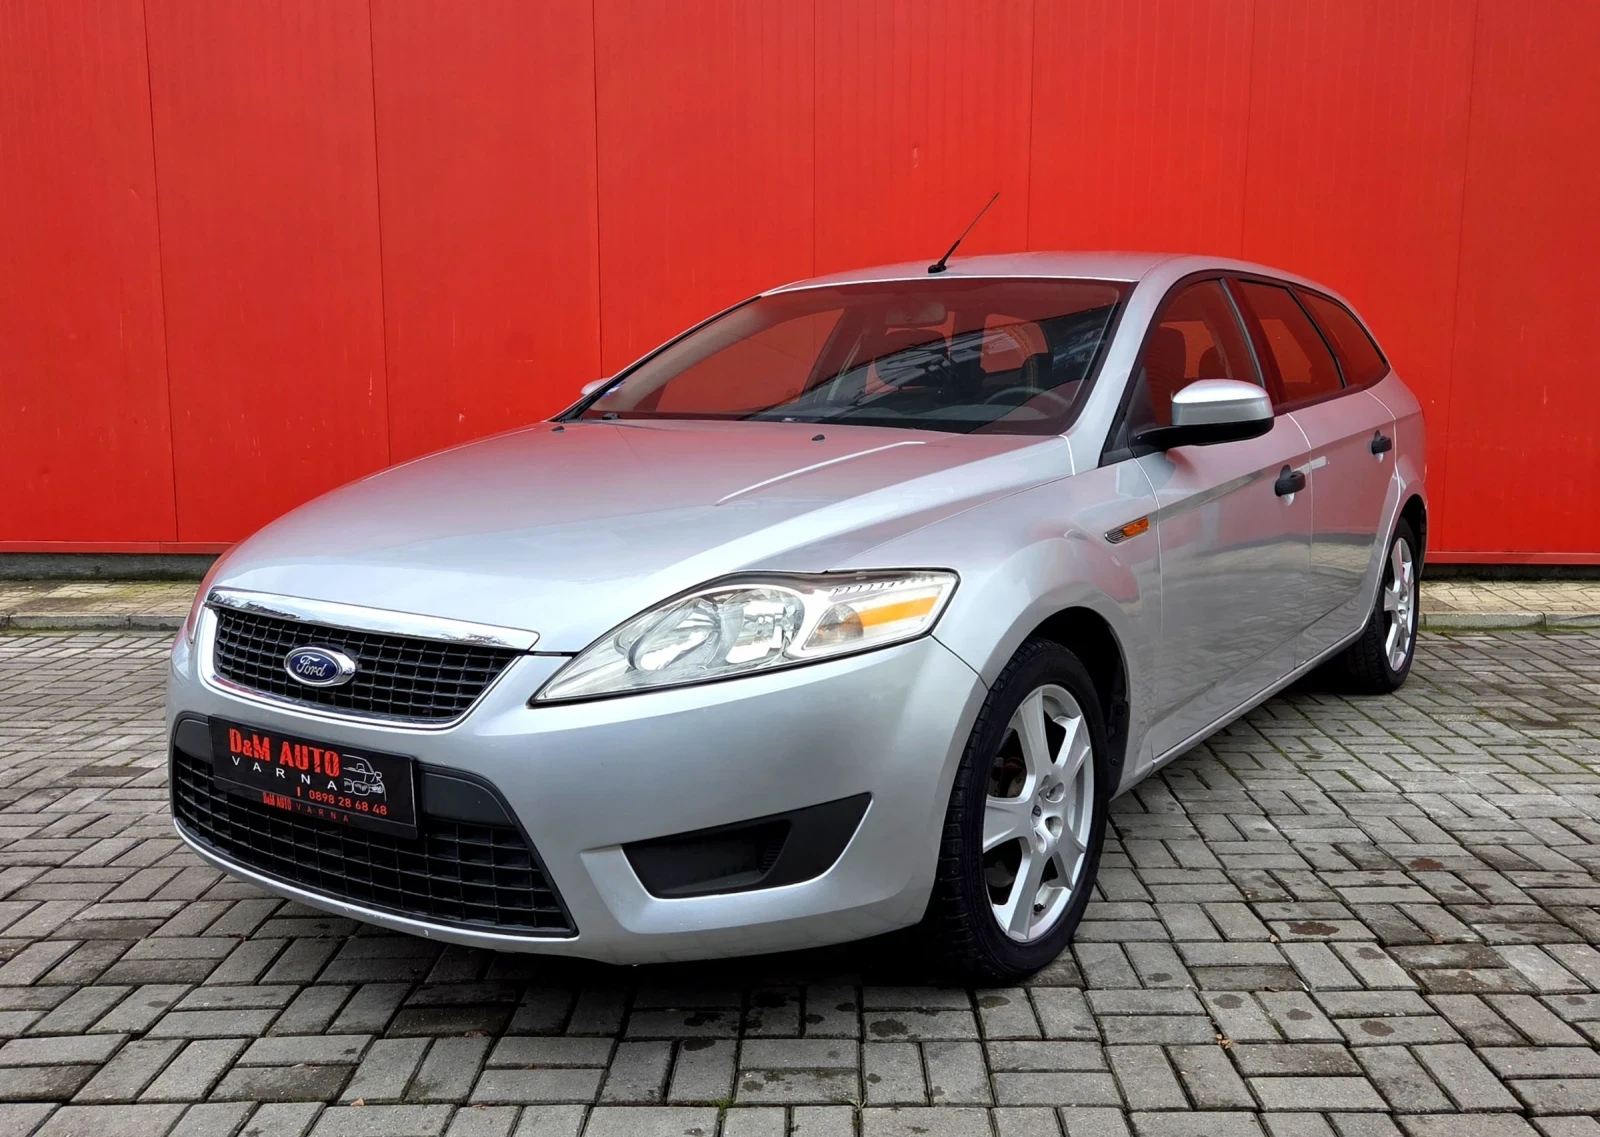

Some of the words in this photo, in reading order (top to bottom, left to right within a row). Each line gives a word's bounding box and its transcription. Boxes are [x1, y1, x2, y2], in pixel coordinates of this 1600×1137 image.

[296, 655, 328, 677] Ford
[229, 728, 270, 762] D&M
[279, 741, 340, 777] AUTO
[276, 795, 292, 811] AUTO
[308, 789, 335, 805] 0898
[338, 797, 352, 808] 28
[355, 799, 369, 812] 68
[372, 802, 388, 816] 48
